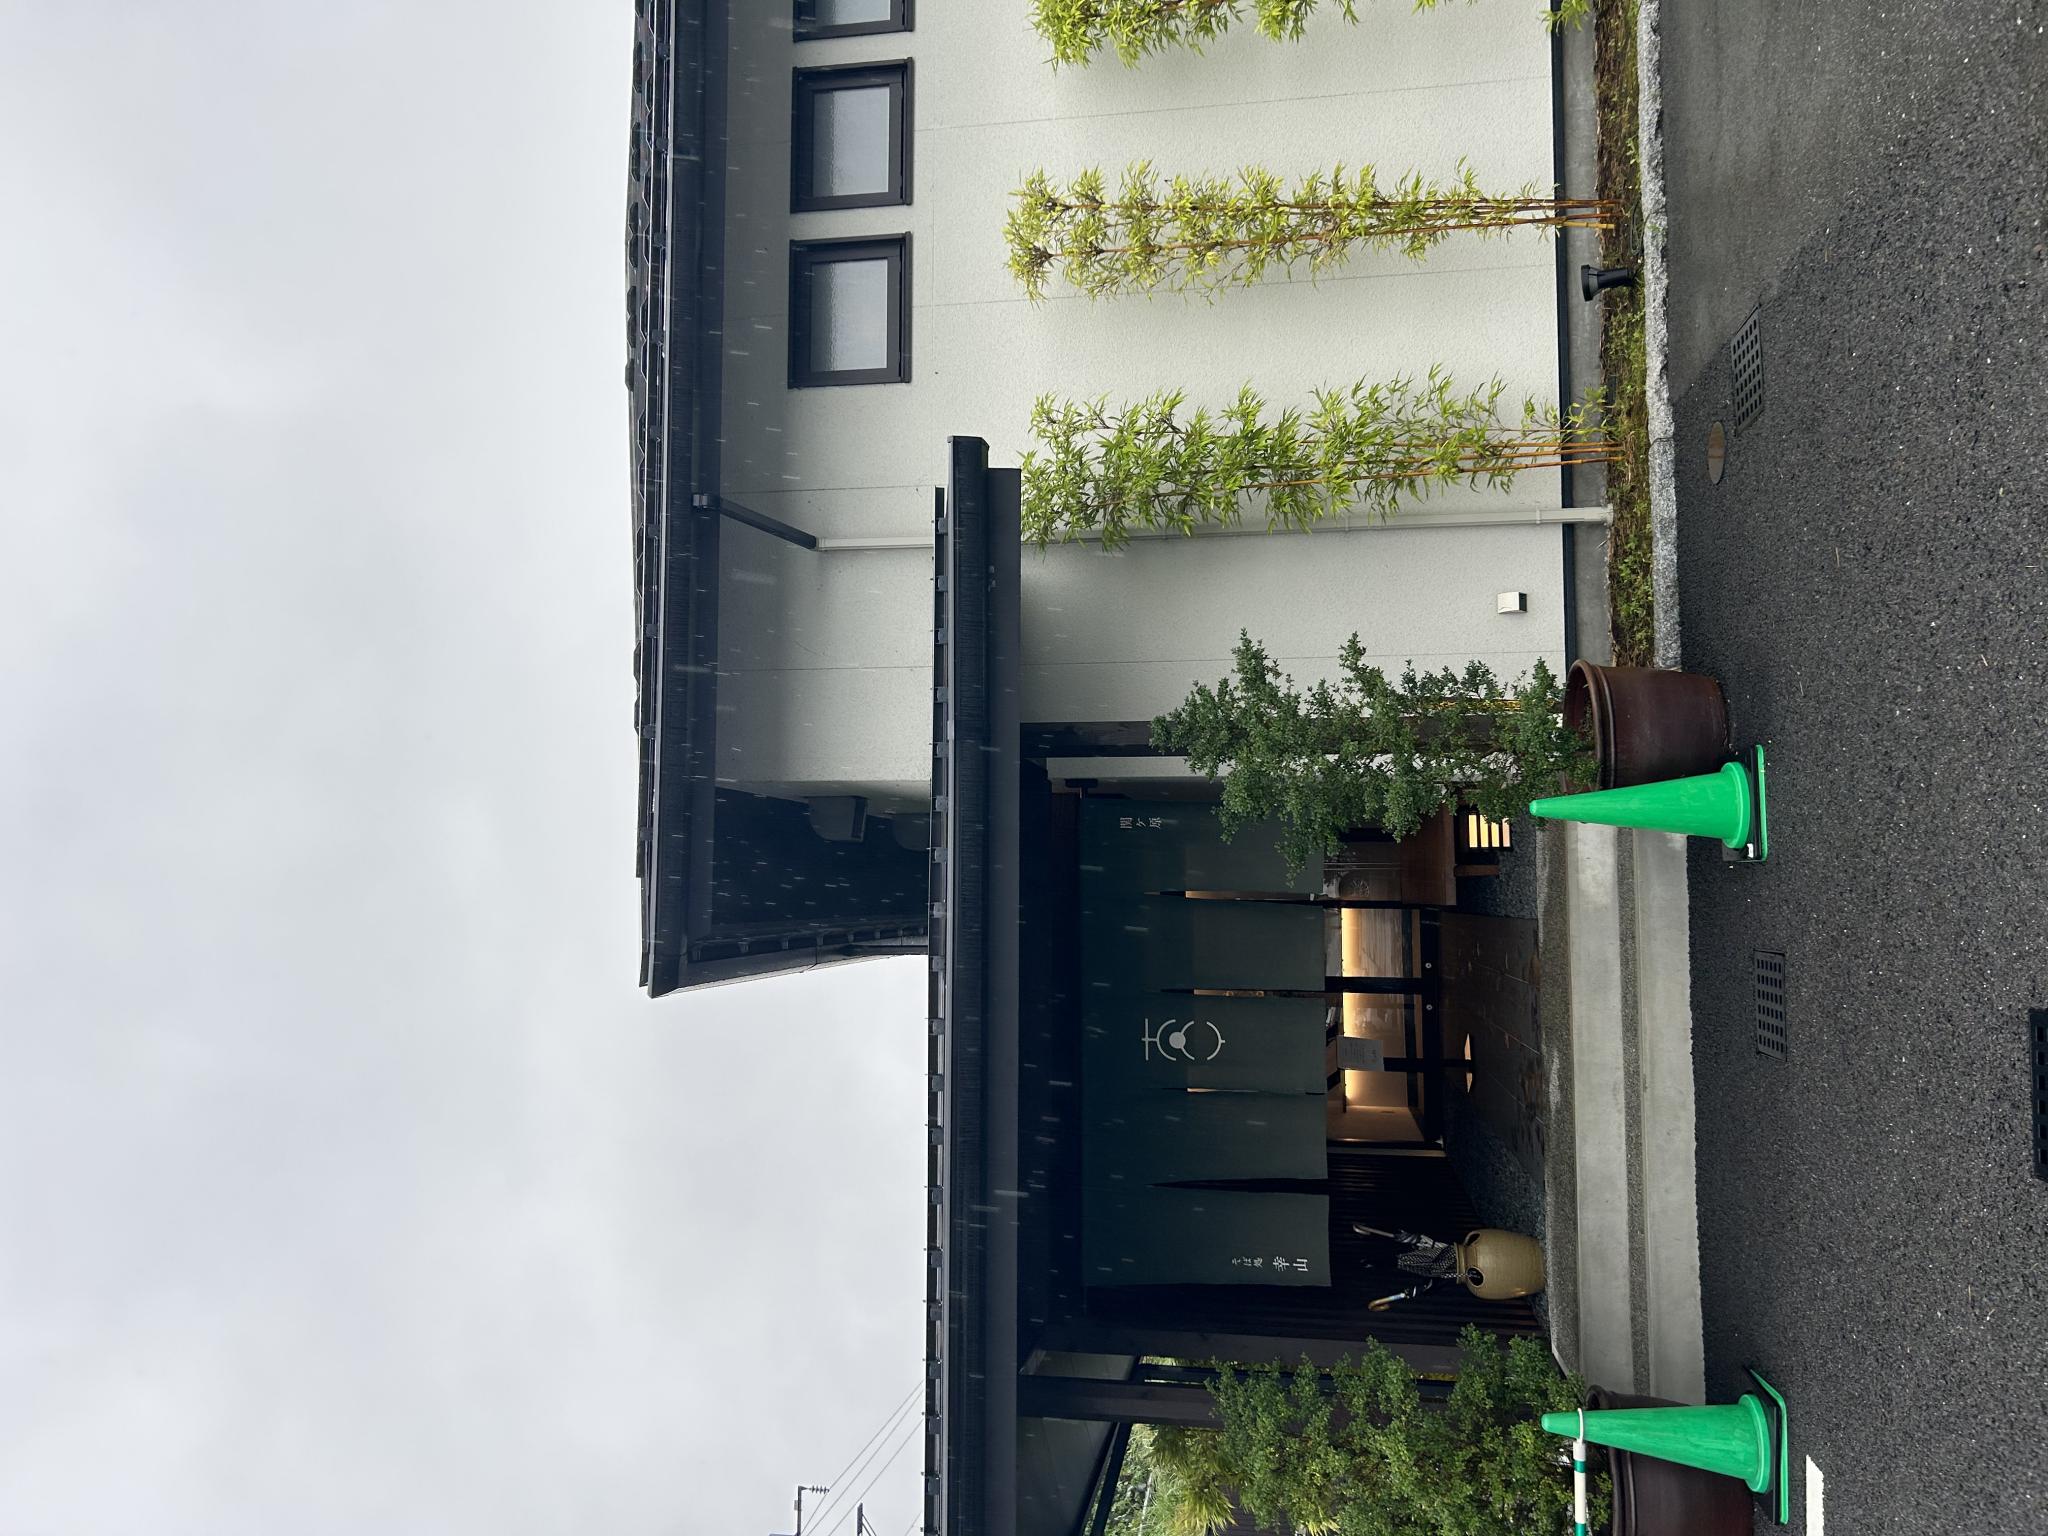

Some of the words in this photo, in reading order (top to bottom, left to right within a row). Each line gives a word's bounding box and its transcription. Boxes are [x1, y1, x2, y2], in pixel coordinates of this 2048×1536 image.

[1231, 1256, 1263, 1268] そば処
[1272, 1256, 1309, 1272] 幸山
